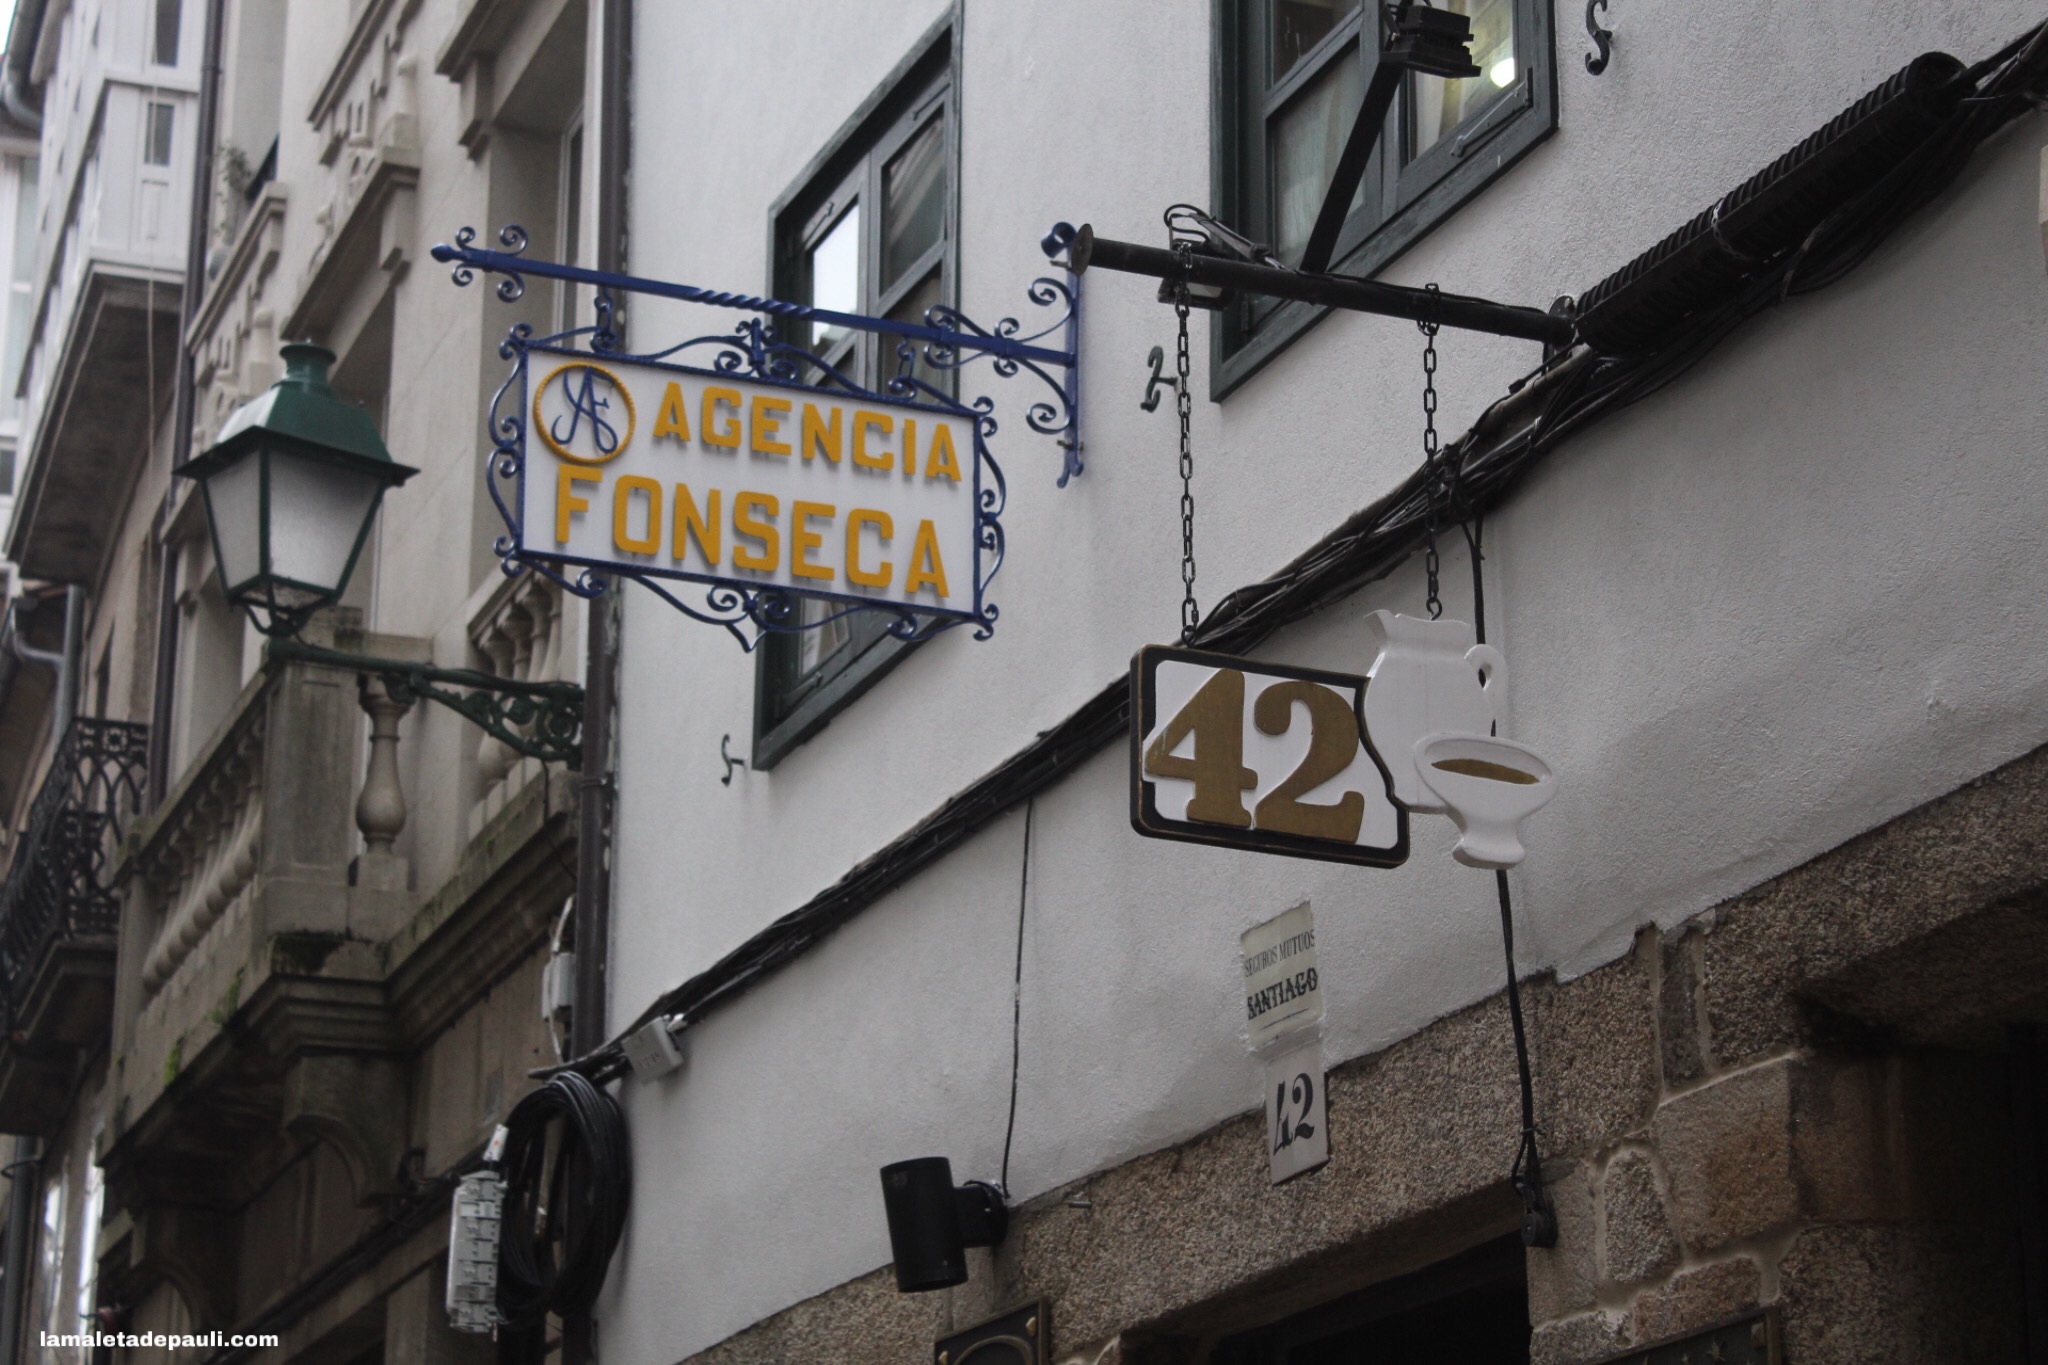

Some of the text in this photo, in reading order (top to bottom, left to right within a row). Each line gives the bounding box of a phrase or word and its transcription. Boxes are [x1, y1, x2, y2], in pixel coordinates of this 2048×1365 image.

[652, 381, 962, 482] AGENCIA
[555, 464, 949, 598] FONSECA
[1144, 668, 1364, 844] 42
[1279, 929, 1315, 961] MUTUOS
[1247, 967, 1318, 1020] SANTIAGO
[1273, 1072, 1315, 1155] 42
